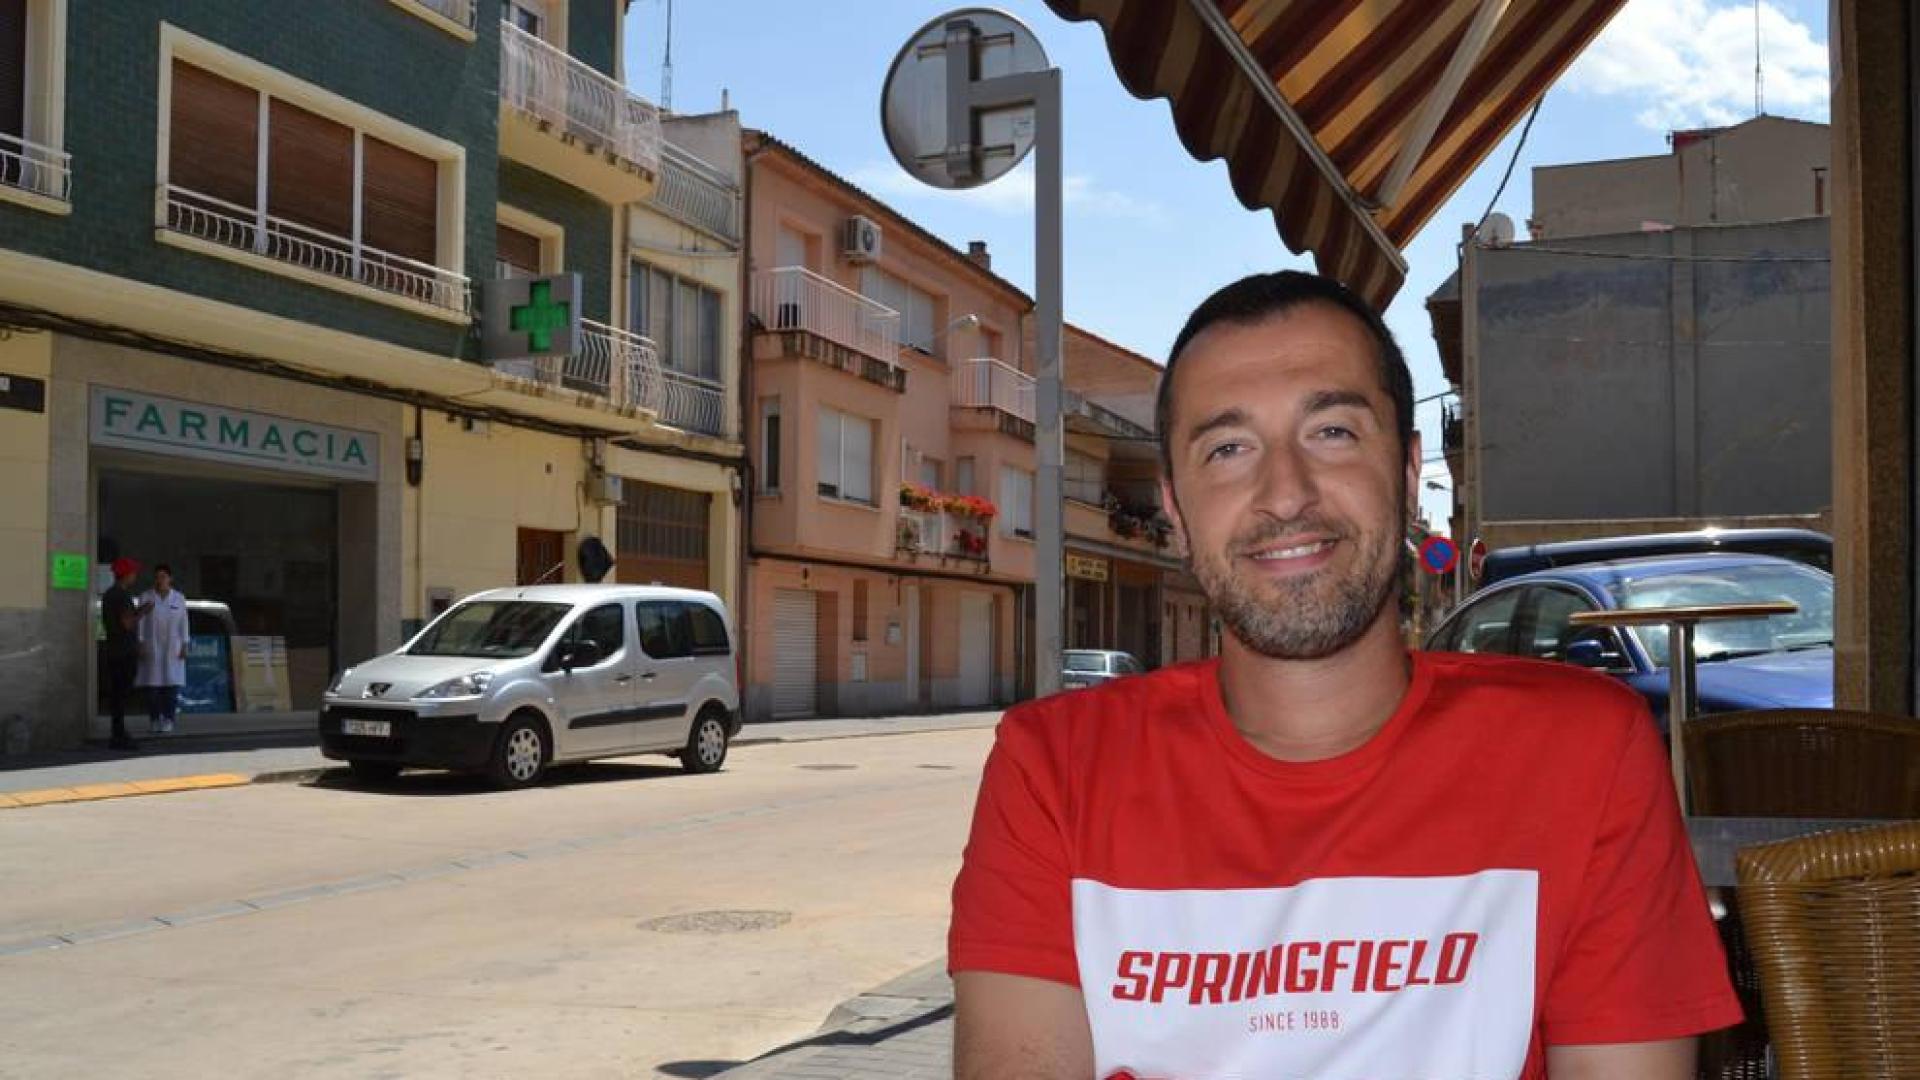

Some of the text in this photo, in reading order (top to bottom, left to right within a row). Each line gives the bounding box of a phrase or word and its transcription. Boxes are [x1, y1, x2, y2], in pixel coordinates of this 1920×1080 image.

[103, 397, 368, 466] FARMACIA
[1112, 932, 1479, 1005] SPRINGFIELD
[1248, 1010, 1339, 1032] SINCE 1988
